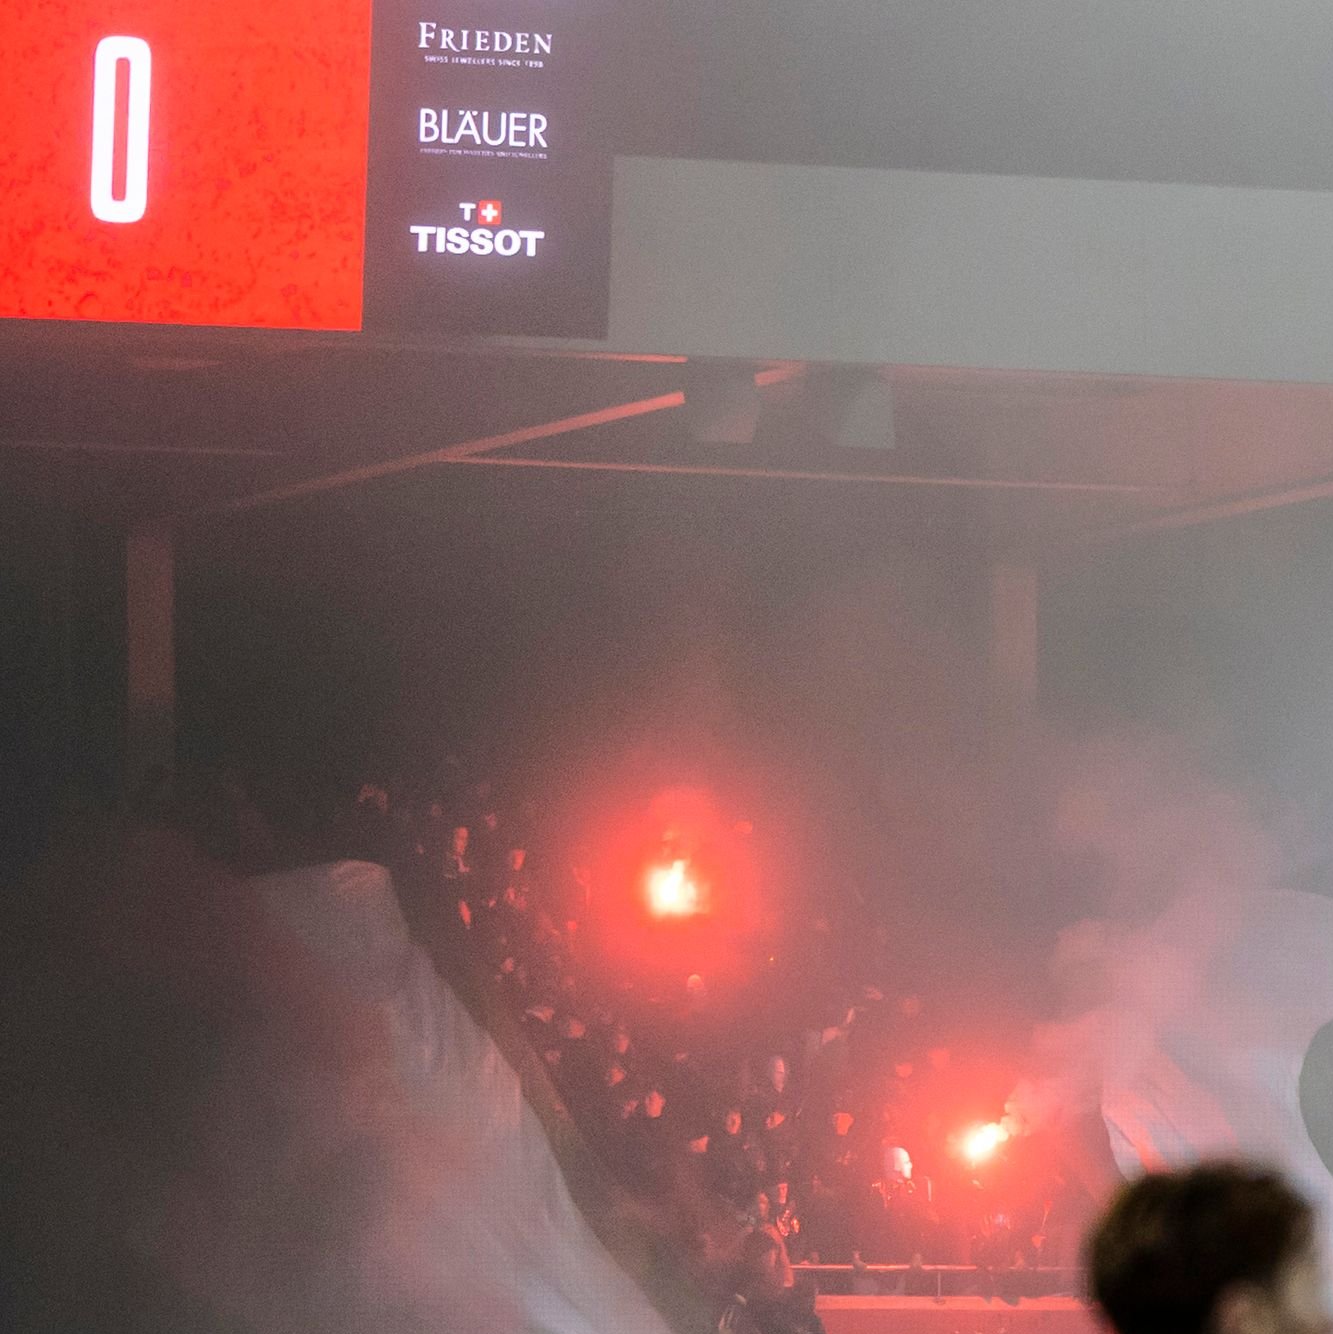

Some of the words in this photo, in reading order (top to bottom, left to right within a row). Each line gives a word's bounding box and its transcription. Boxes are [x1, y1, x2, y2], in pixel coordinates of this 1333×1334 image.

[418, 21, 553, 54] FRIEDEN
[90, 35, 152, 223] 0
[419, 107, 548, 148] BLÄUER
[409, 225, 545, 257] TISSOT
